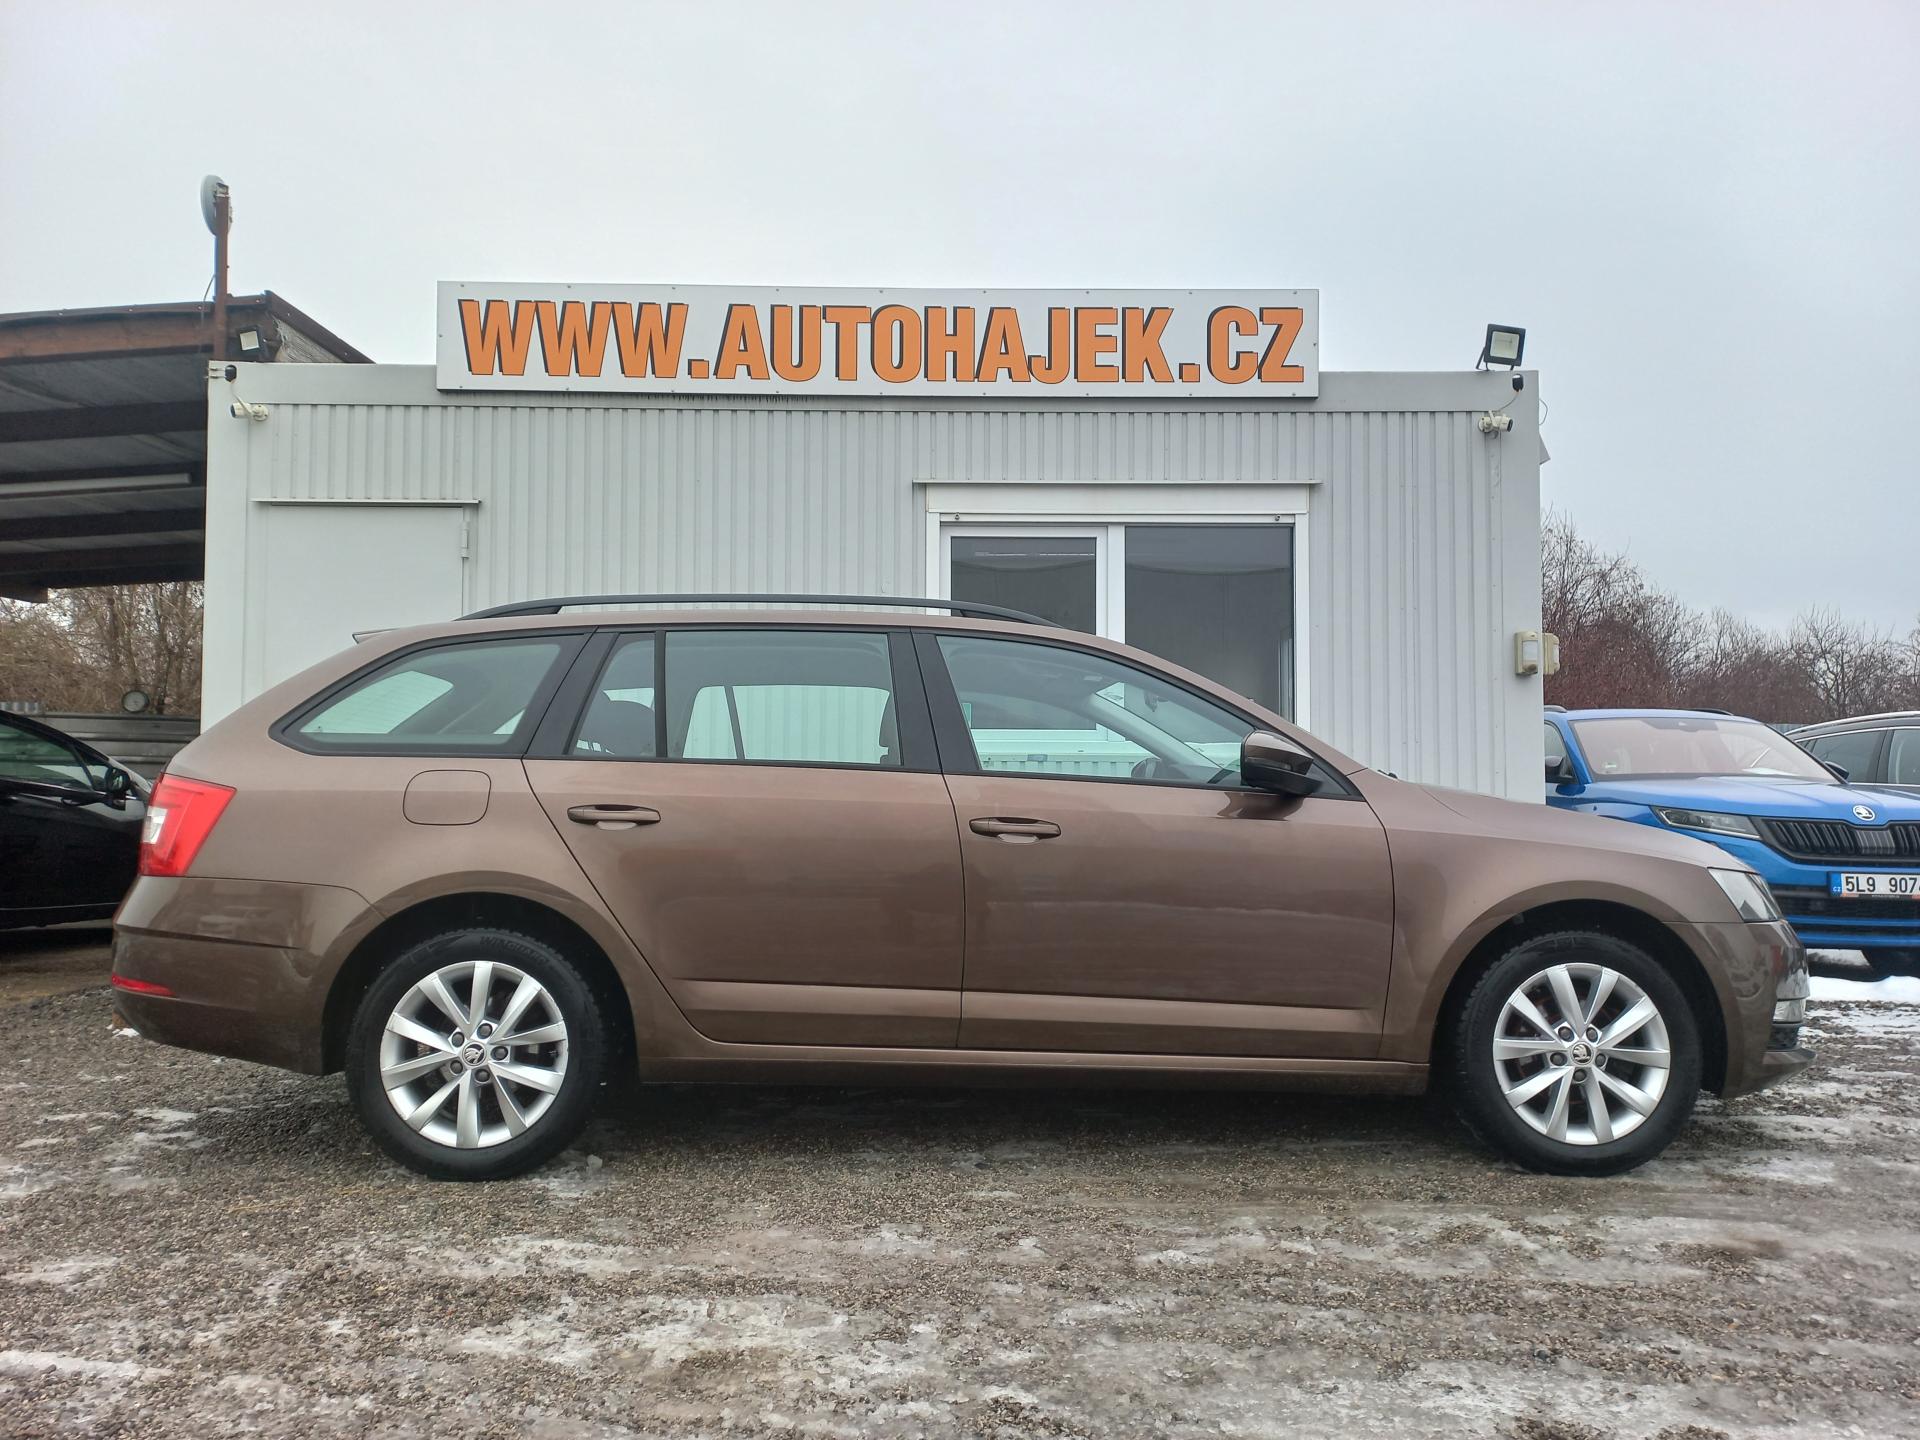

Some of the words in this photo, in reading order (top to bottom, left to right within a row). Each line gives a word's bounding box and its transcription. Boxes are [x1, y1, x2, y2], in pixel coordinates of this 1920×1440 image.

[458, 299, 1304, 384] WWW.AUTOHAJEK.CZ
[1845, 876, 1876, 893] 5L9
[1889, 877, 1920, 894] 907
